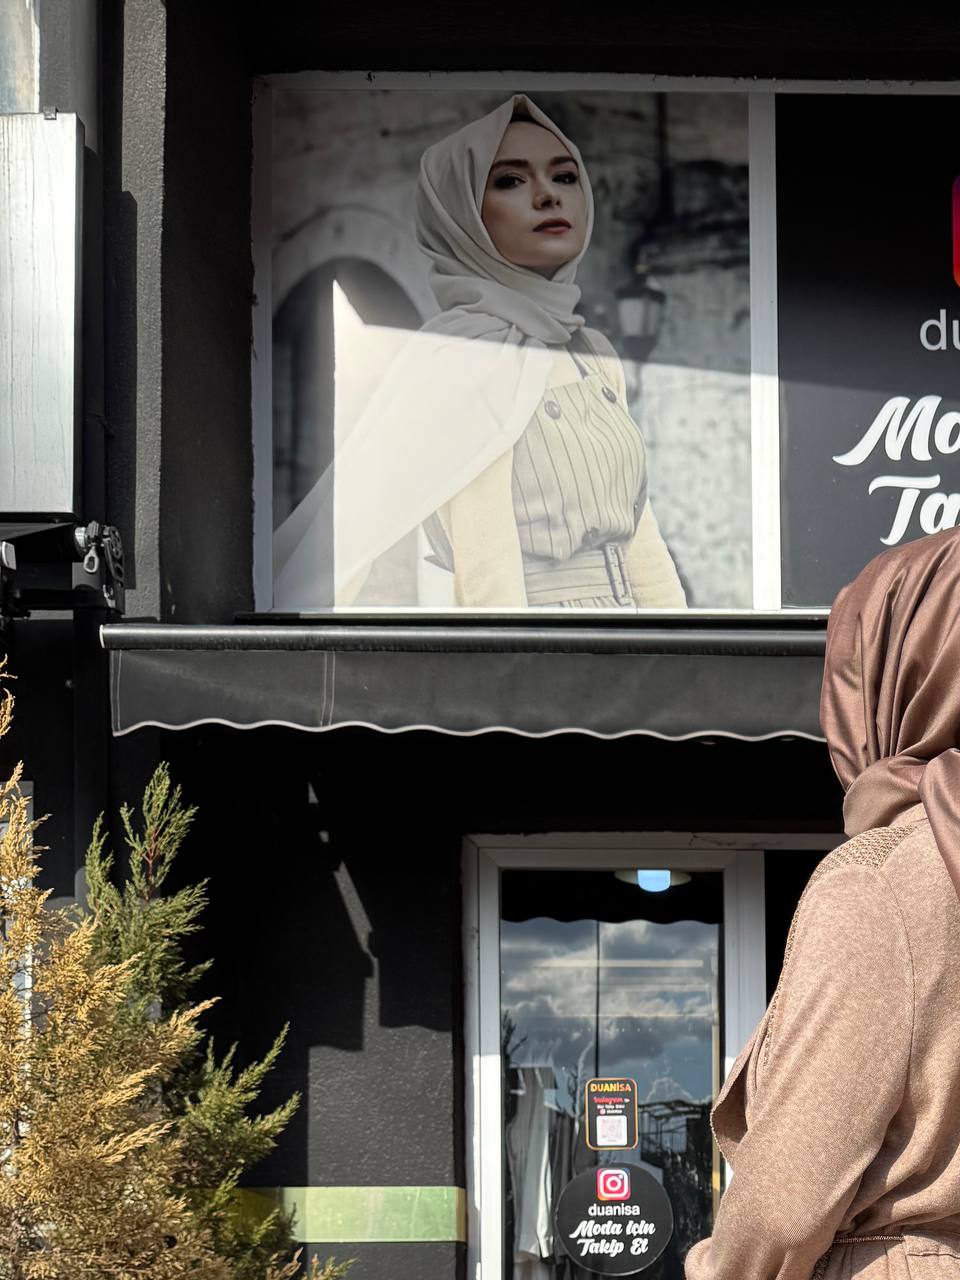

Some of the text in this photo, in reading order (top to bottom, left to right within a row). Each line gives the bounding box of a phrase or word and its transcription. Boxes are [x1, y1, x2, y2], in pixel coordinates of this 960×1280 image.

[587, 1203, 641, 1217] duanisa
[568, 1219, 623, 1239] Moda
[576, 1237, 649, 1258] Takip Et
